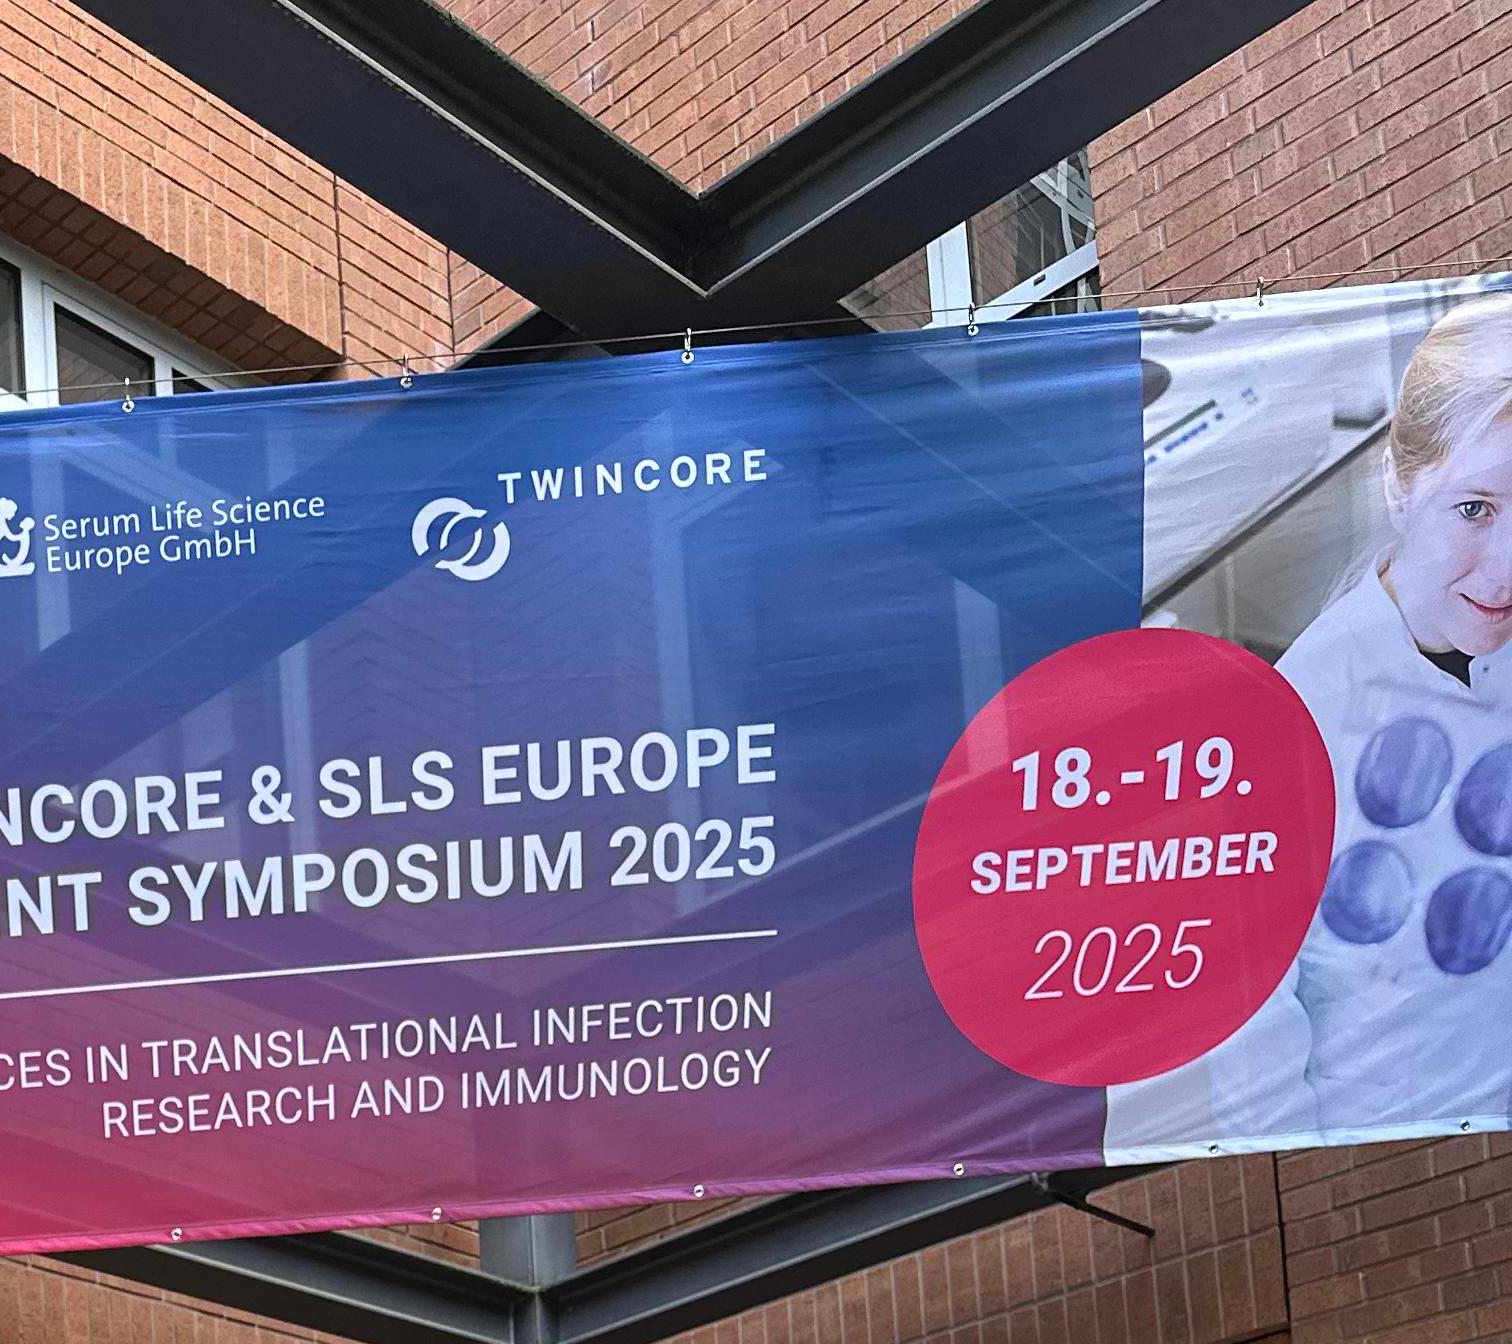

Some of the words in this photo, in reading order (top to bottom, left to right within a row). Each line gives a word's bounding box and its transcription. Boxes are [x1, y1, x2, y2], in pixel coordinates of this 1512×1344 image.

[497, 448, 769, 504] TWINCORE
[43, 508, 141, 541] Serum
[149, 499, 204, 531] Life
[212, 494, 326, 527] Science
[46, 537, 151, 575] Europe
[159, 528, 257, 562] GmbH
[248, 765, 296, 825] &
[319, 749, 455, 820] SLS
[482, 722, 777, 806] EUROPE
[1012, 735, 1253, 812] 18.-19.
[128, 829, 584, 927] SYMPOSIUM
[608, 814, 776, 887] 2025
[969, 830, 1279, 895] SEPTEMBER
[1024, 918, 1213, 1001] 2025
[85, 1044, 129, 1084] IN
[140, 1011, 519, 1079] TRANSLATIONAL
[532, 990, 773, 1048] INFECTION
[102, 1084, 337, 1139] RESEARCH
[350, 1074, 445, 1120] AND
[461, 1046, 773, 1110] IMMUNOLOGY
